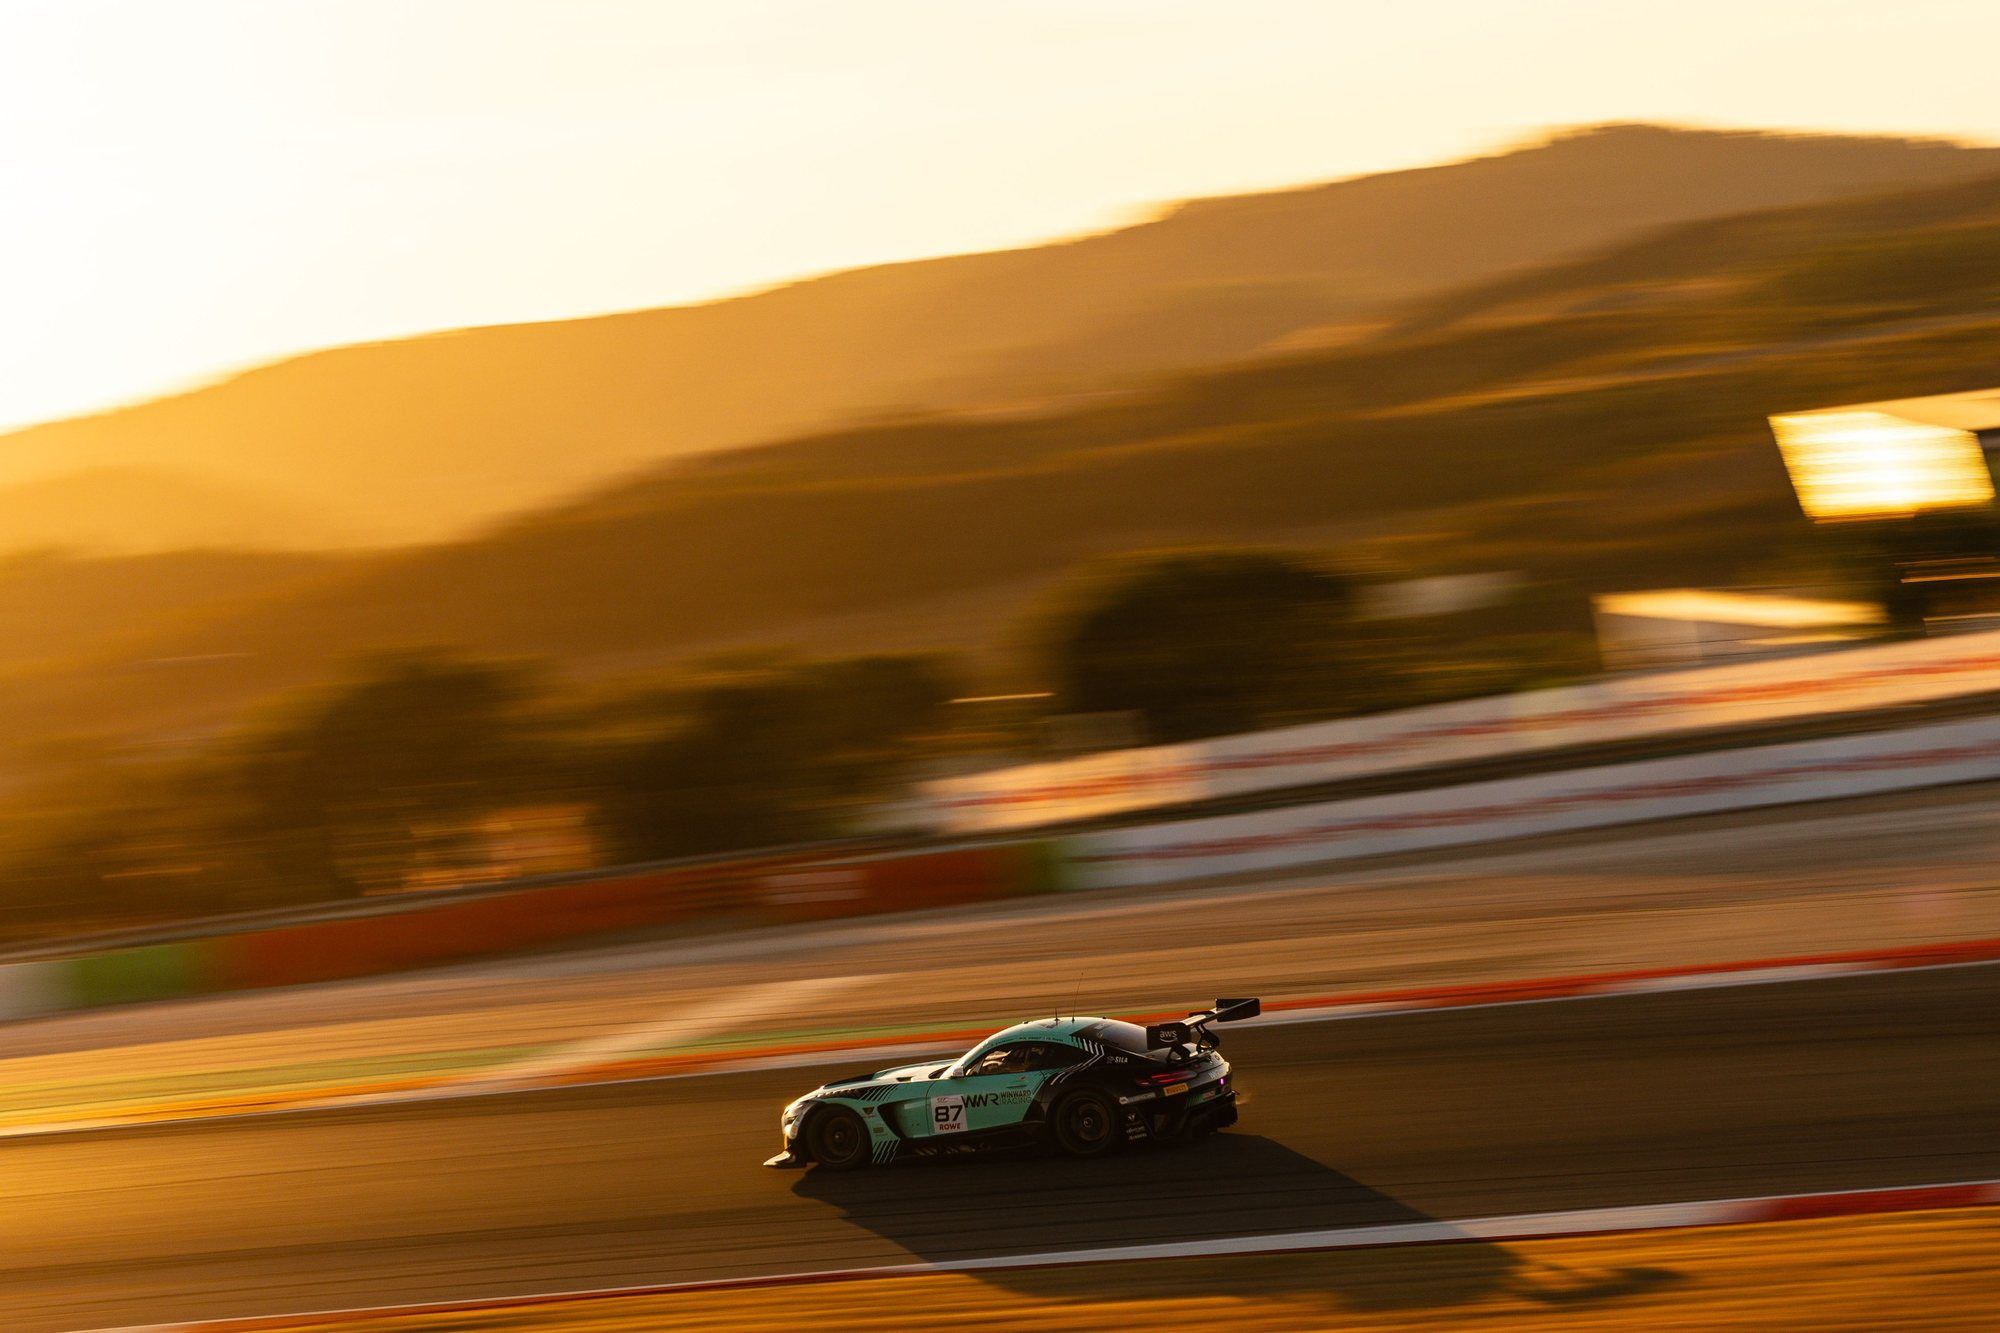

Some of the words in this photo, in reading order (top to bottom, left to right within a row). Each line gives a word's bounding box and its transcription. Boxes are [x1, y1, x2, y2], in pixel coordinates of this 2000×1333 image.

[1160, 1030, 1178, 1039] aws
[1001, 1090, 1031, 1098] WINWARD
[1001, 1097, 1031, 1105] RACING
[935, 1105, 963, 1122] 87
